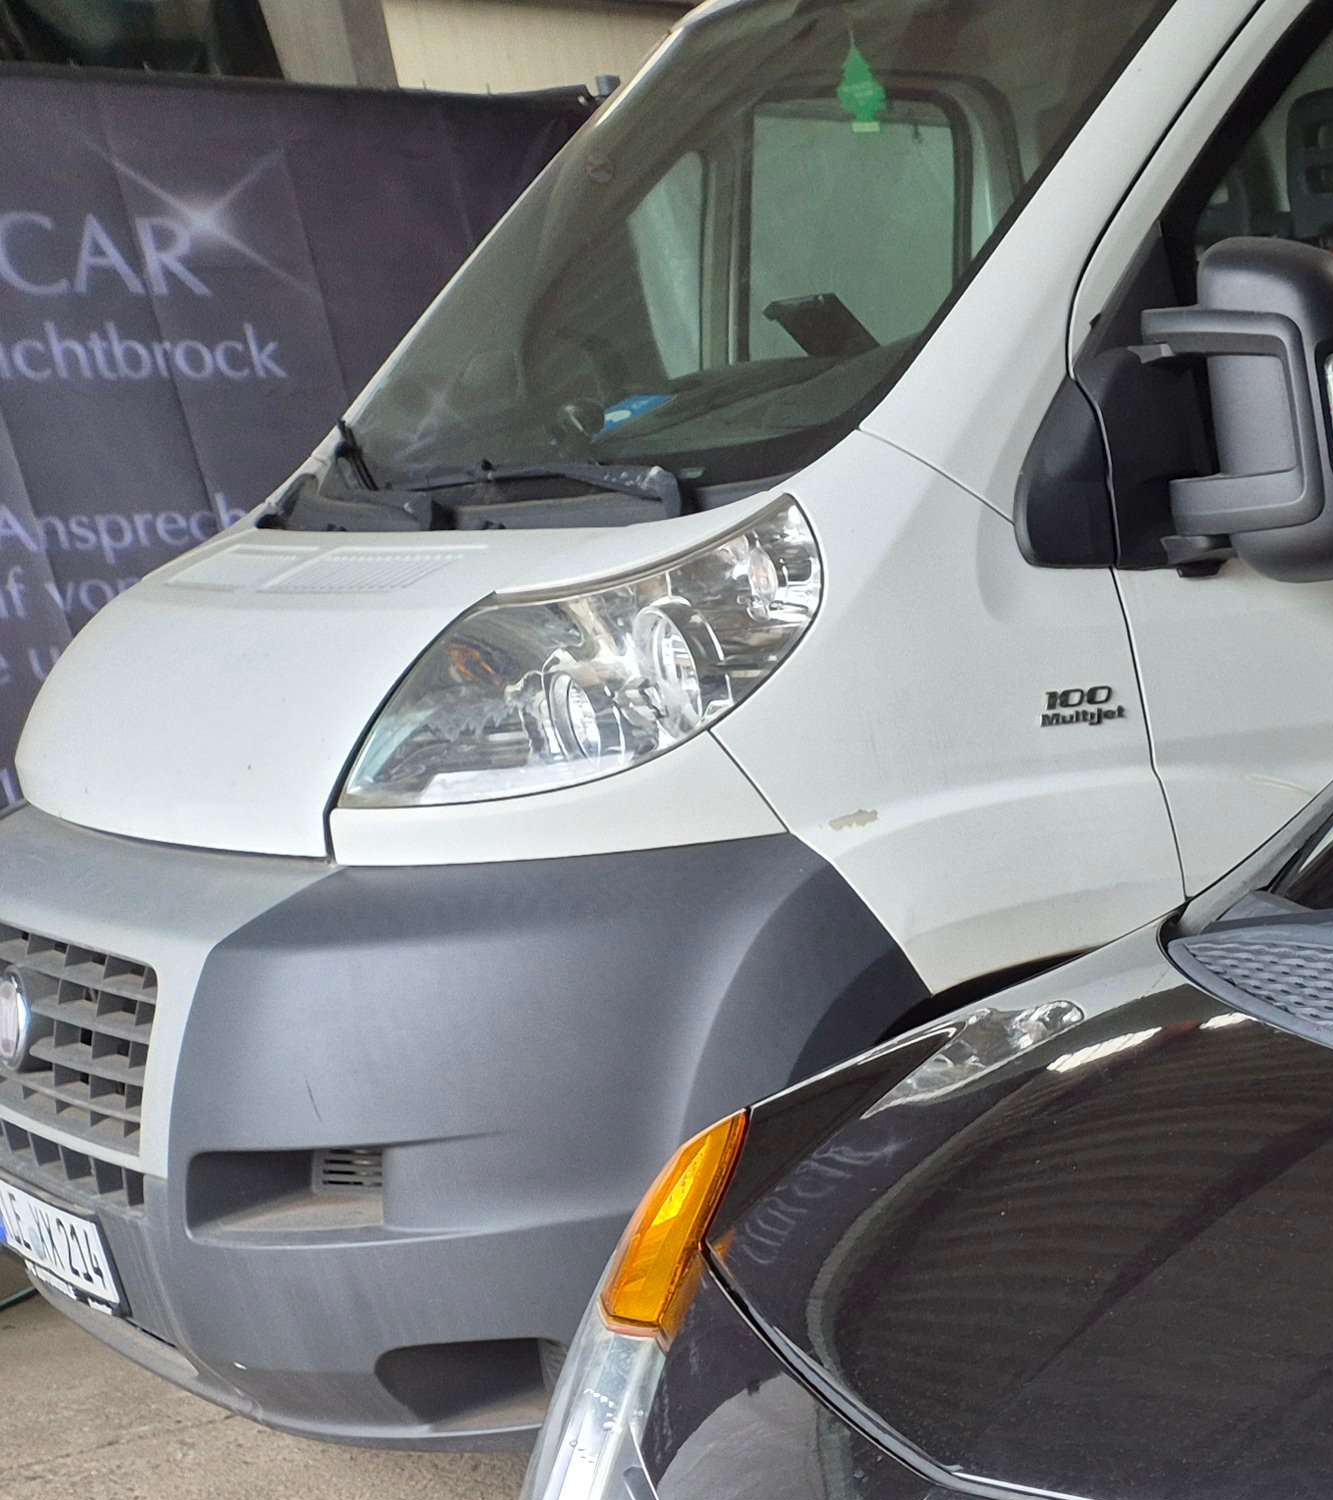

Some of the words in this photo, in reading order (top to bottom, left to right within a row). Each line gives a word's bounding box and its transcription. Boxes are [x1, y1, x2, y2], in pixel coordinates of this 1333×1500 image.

[0, 211, 212, 296] CAR
[1041, 705, 1125, 727] Multijet
[1045, 685, 1113, 710] 100
[56, 1217, 108, 1291] 214
